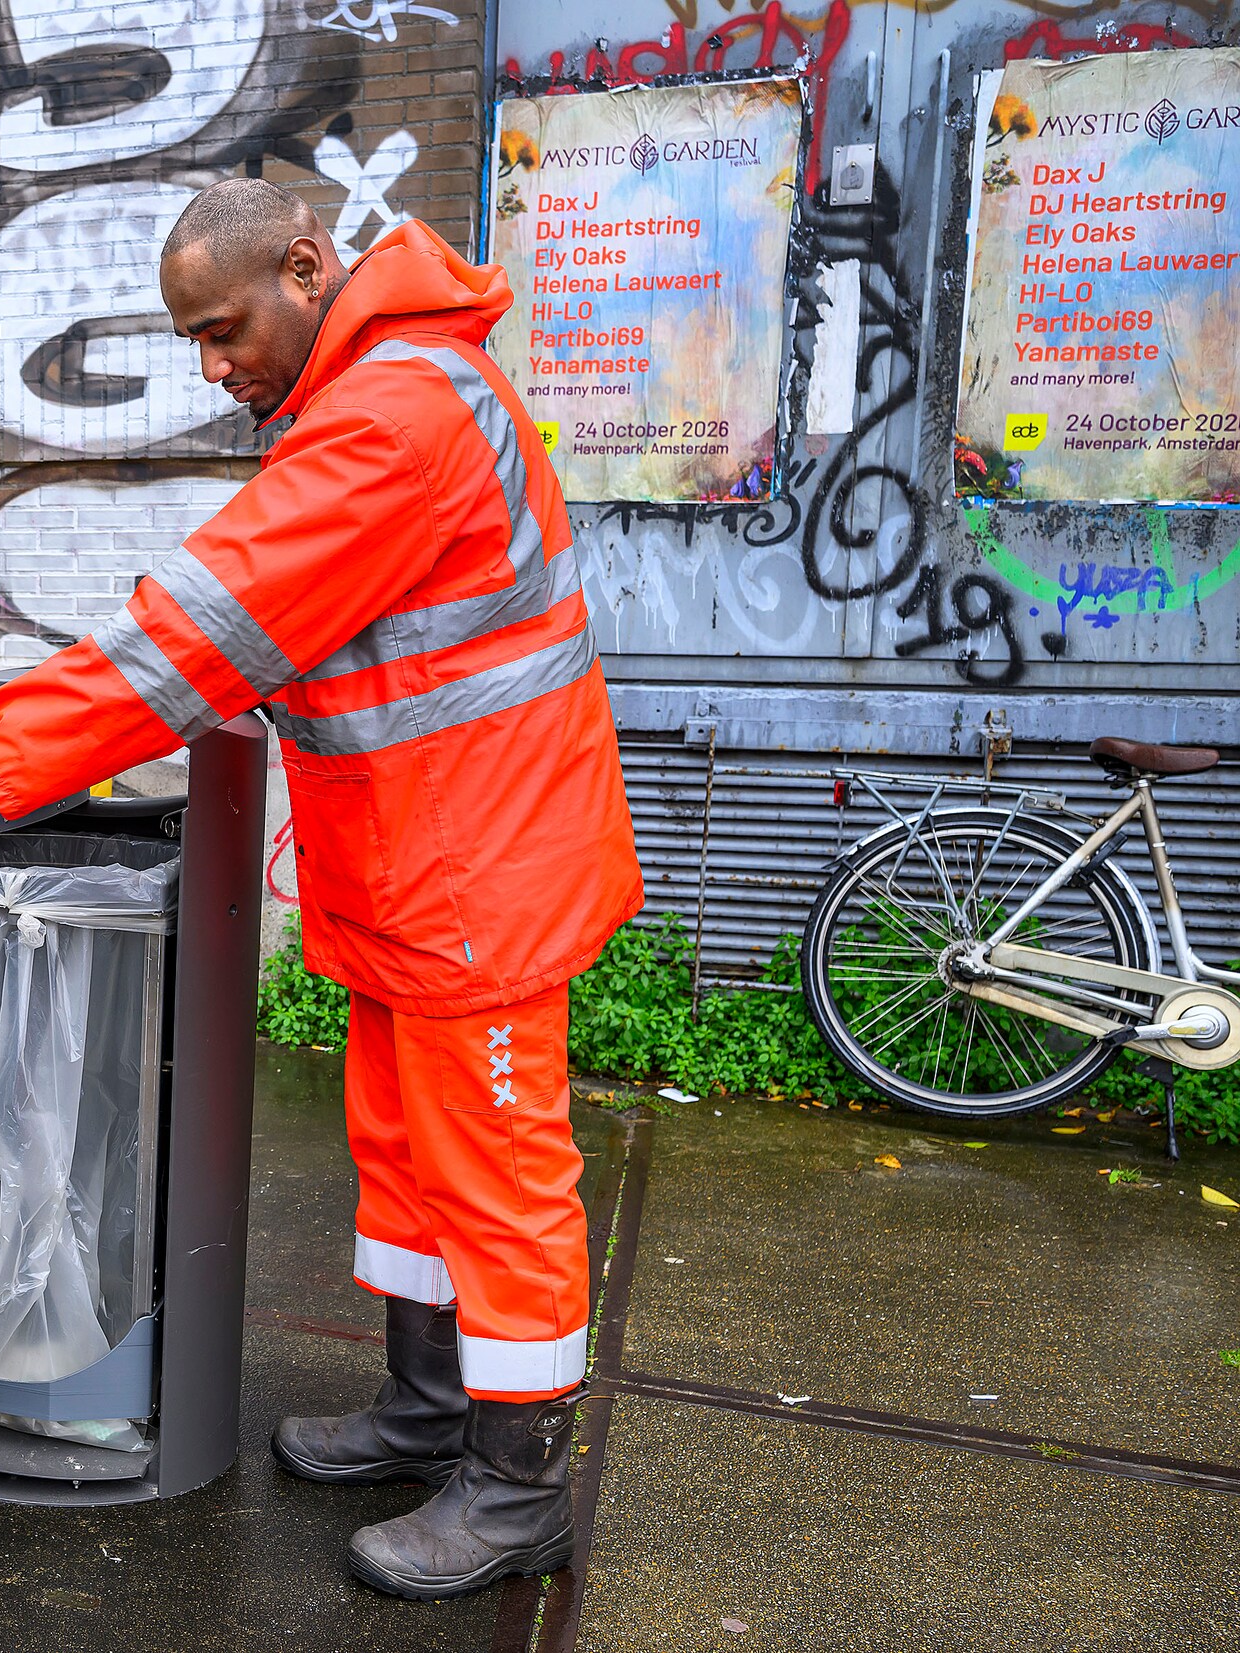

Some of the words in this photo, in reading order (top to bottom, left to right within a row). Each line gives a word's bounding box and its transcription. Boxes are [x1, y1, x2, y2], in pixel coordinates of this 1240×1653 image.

[1038, 111, 1140, 138] MYSTIC
[540, 145, 626, 169] MYSTIC
[663, 138, 758, 162] GARDEN
[1033, 164, 1082, 186] Dax
[1087, 162, 1105, 183] J
[538, 194, 579, 213] Dax
[584, 192, 599, 211] J
[1029, 193, 1064, 215] DJ
[1071, 188, 1227, 214] Heartstring
[536, 220, 565, 240] DJ
[572, 215, 701, 239] Heartstring
[1025, 224, 1065, 249] Ely
[1071, 222, 1136, 244] Oaks
[535, 248, 567, 271] Ely
[573, 246, 627, 266] Oaks
[1022, 253, 1112, 275] Helena
[1120, 251, 1240, 273] Lauwaer
[533, 275, 607, 294] Helena
[614, 270, 722, 292] Lauwaert
[1019, 282, 1093, 304] HI-LO
[531, 301, 593, 321] HI-LO
[1016, 310, 1153, 333] Partiboi69
[530, 326, 644, 348] Partiboi69
[1014, 342, 1159, 362] Yanamaste
[529, 355, 650, 375] Yanamaste
[527, 384, 550, 396] and
[553, 385, 589, 398] many
[592, 383, 631, 395] more!
[1010, 373, 1038, 386] and
[1042, 373, 1085, 388] many
[1089, 371, 1135, 385] more!
[575, 422, 597, 438] 24
[603, 421, 677, 438] October
[682, 420, 729, 438] 2026
[1066, 414, 1093, 432] 24
[1100, 414, 1190, 432] October
[1195, 413, 1240, 432] 202
[573, 443, 647, 457] Havenpark,
[651, 442, 729, 455] Amsterdam
[1064, 437, 1152, 452] Havenpark,
